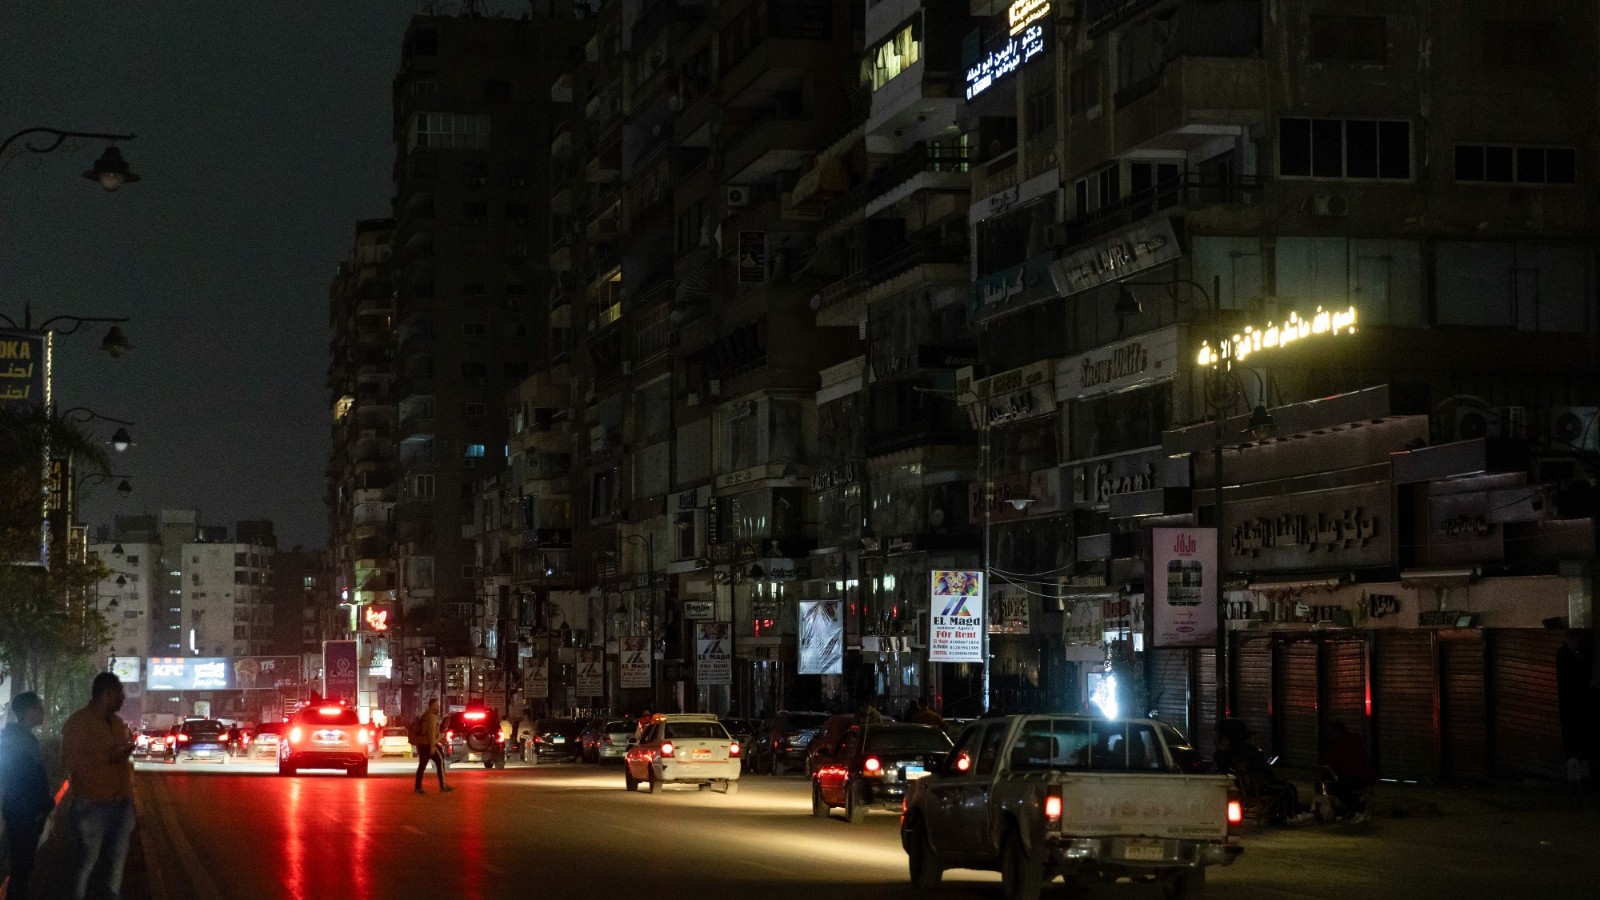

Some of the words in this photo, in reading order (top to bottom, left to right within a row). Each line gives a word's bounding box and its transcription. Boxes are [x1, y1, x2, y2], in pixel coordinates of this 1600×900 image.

[1312, 305, 1330, 334] الله
[1332, 306, 1356, 335] بسم
[1262, 320, 1279, 347] الله
[933, 617, 946, 625] EL
[950, 617, 980, 626] Magd
[152, 664, 184, 676] KFC
